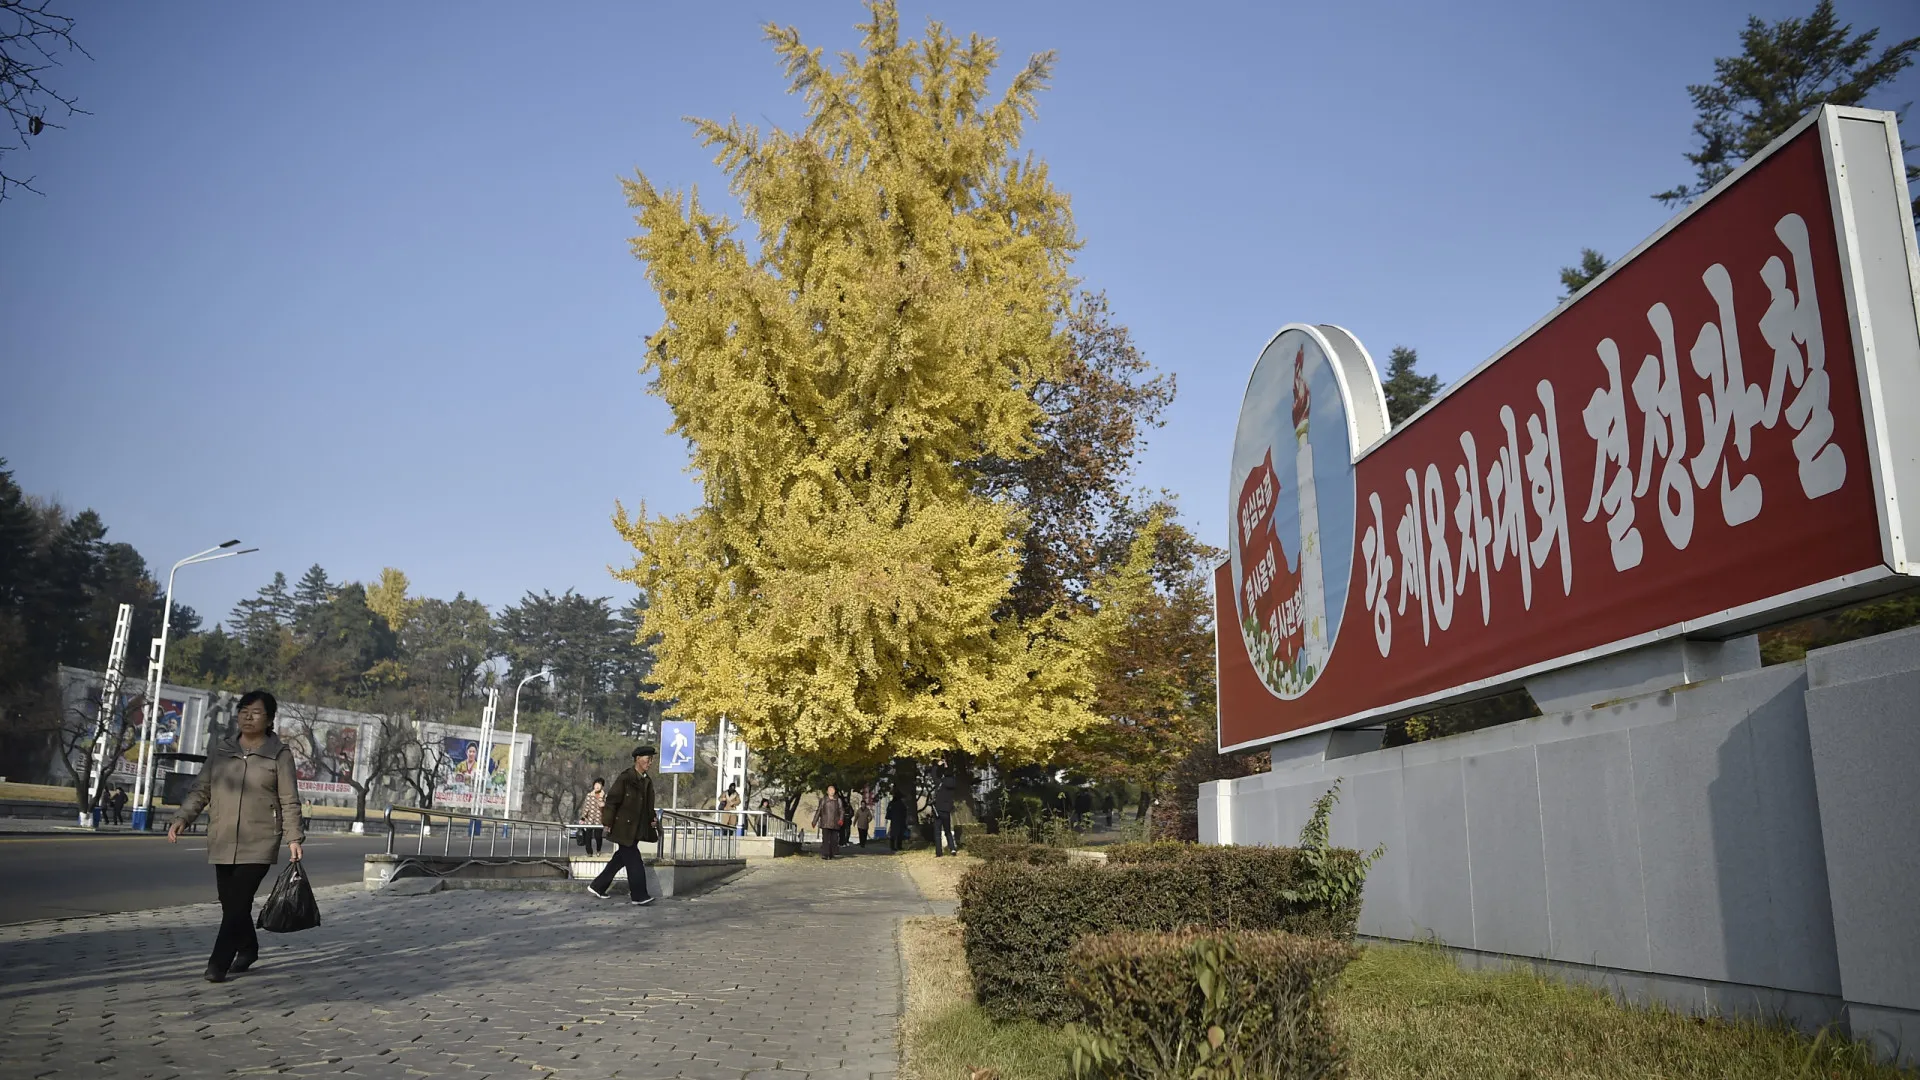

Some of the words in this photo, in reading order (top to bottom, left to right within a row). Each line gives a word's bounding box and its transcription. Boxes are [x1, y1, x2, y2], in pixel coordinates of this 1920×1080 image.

[1361, 491, 1394, 658] 당
[1581, 212, 1848, 573] 결정관철
[1242, 468, 1273, 547] 일심단결
[1245, 541, 1277, 623] 결사옹위
[1269, 583, 1304, 655] 결사관철
